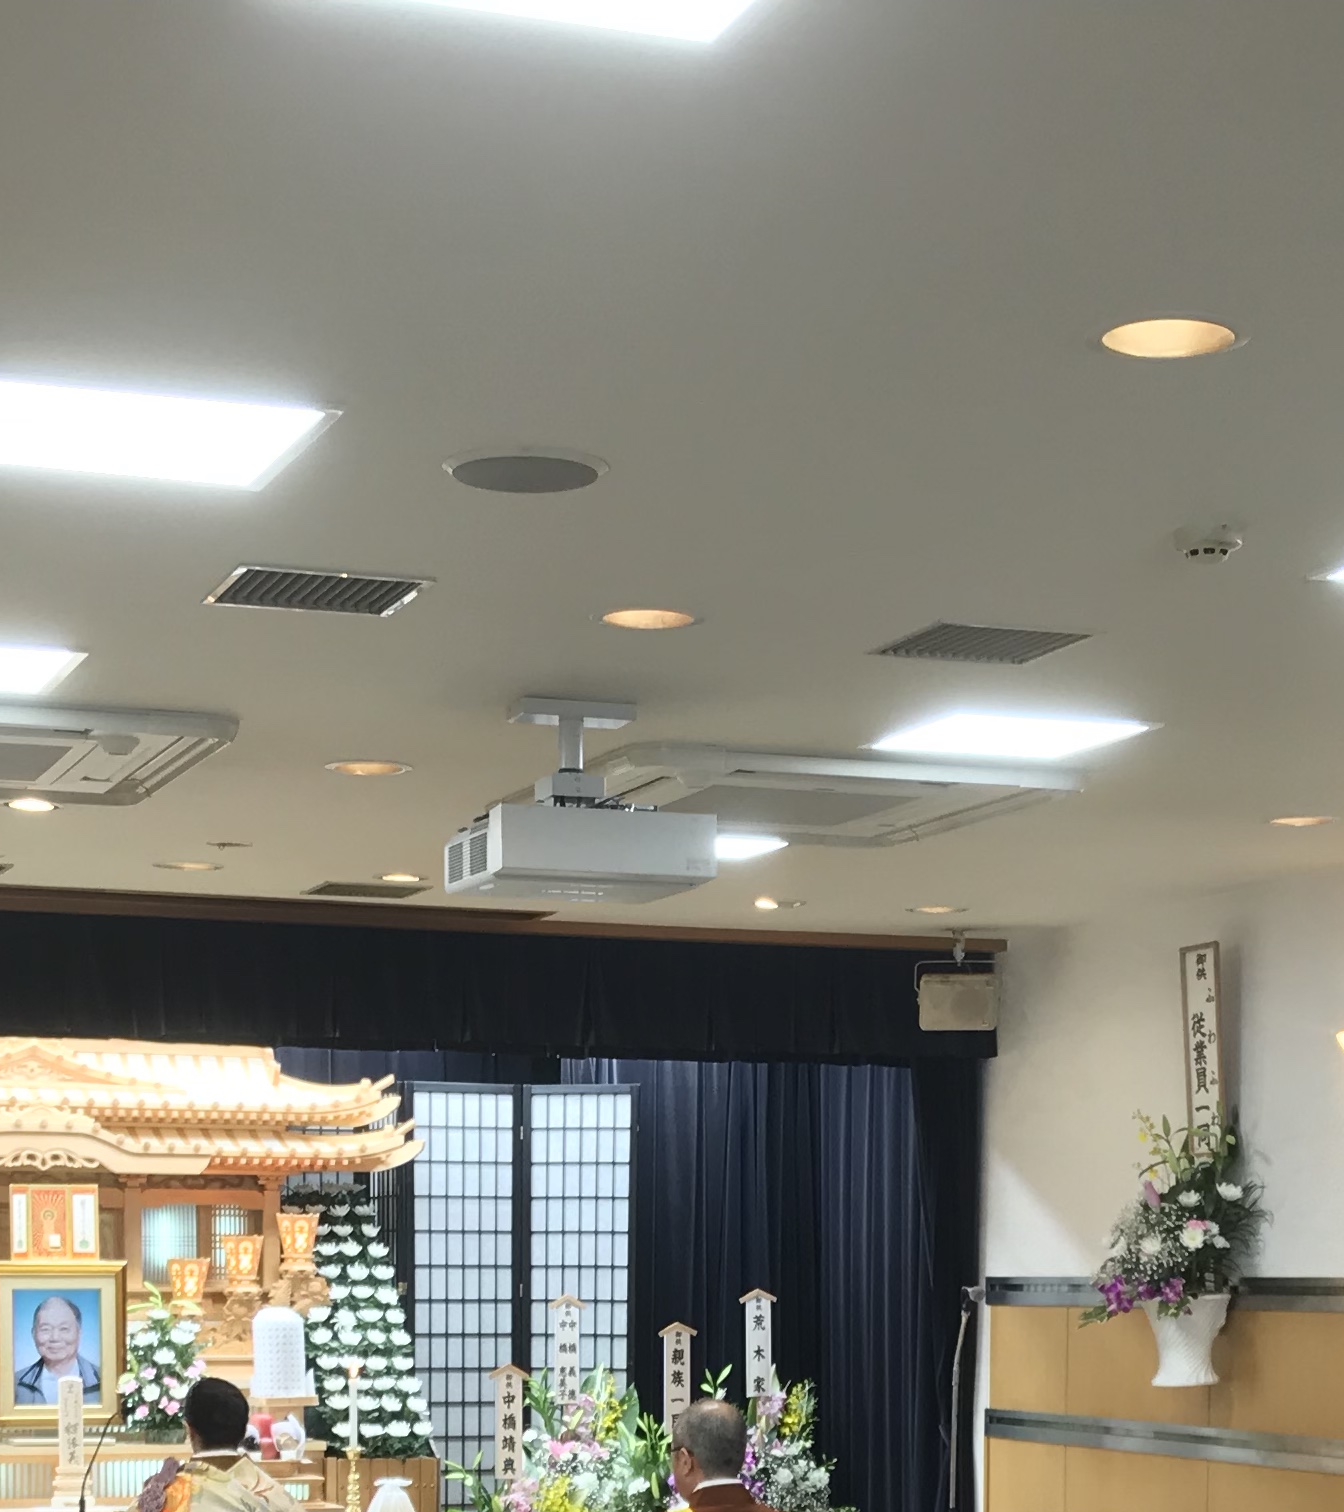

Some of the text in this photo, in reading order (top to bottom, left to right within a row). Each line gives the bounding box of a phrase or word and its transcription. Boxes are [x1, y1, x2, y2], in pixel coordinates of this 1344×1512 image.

[1191, 1011, 1212, 1152] 従業員一同
[752, 1314, 766, 1394] 荒木家
